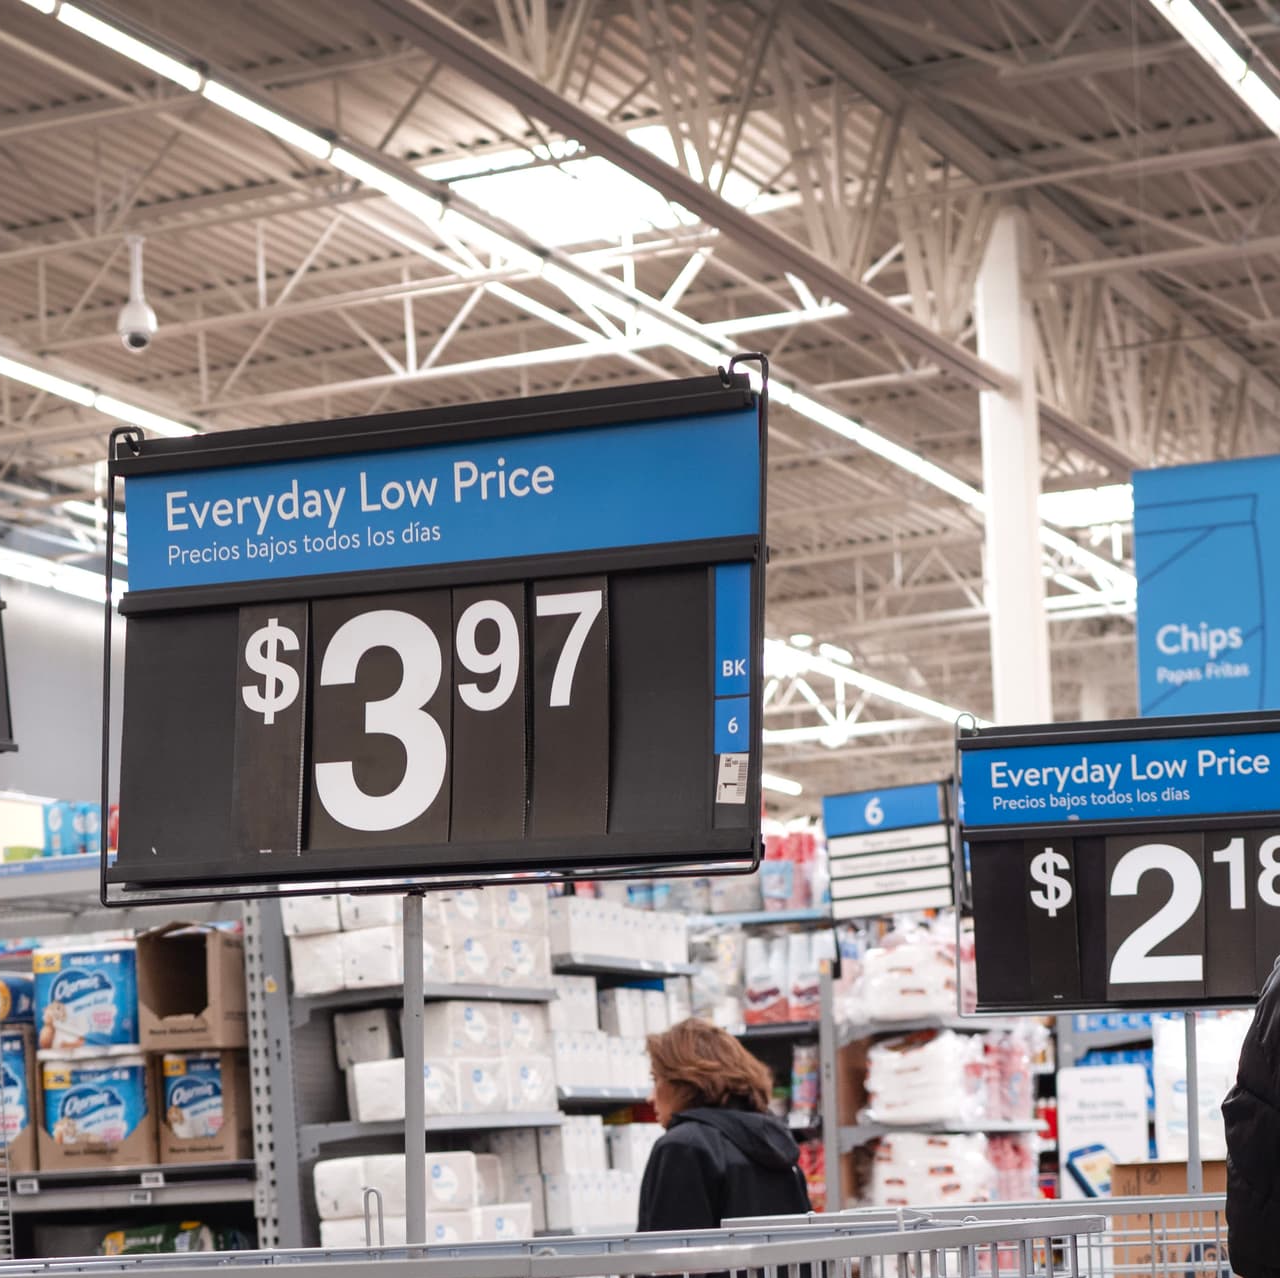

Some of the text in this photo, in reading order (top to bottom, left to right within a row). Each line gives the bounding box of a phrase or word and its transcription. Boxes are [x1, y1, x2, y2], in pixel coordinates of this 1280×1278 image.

[166, 457, 555, 535] Everyday Low Price
[168, 520, 441, 566] Precios bajos todos los días
[1156, 621, 1243, 659] Chips
[722, 659, 746, 676] BK
[1156, 662, 1249, 685] Papas Fritas
[727, 716, 739, 734] 6
[990, 748, 1271, 792] Everyday Low Price
[864, 797, 885, 826] 6
[992, 786, 1190, 812] Precios bajos todos los días
